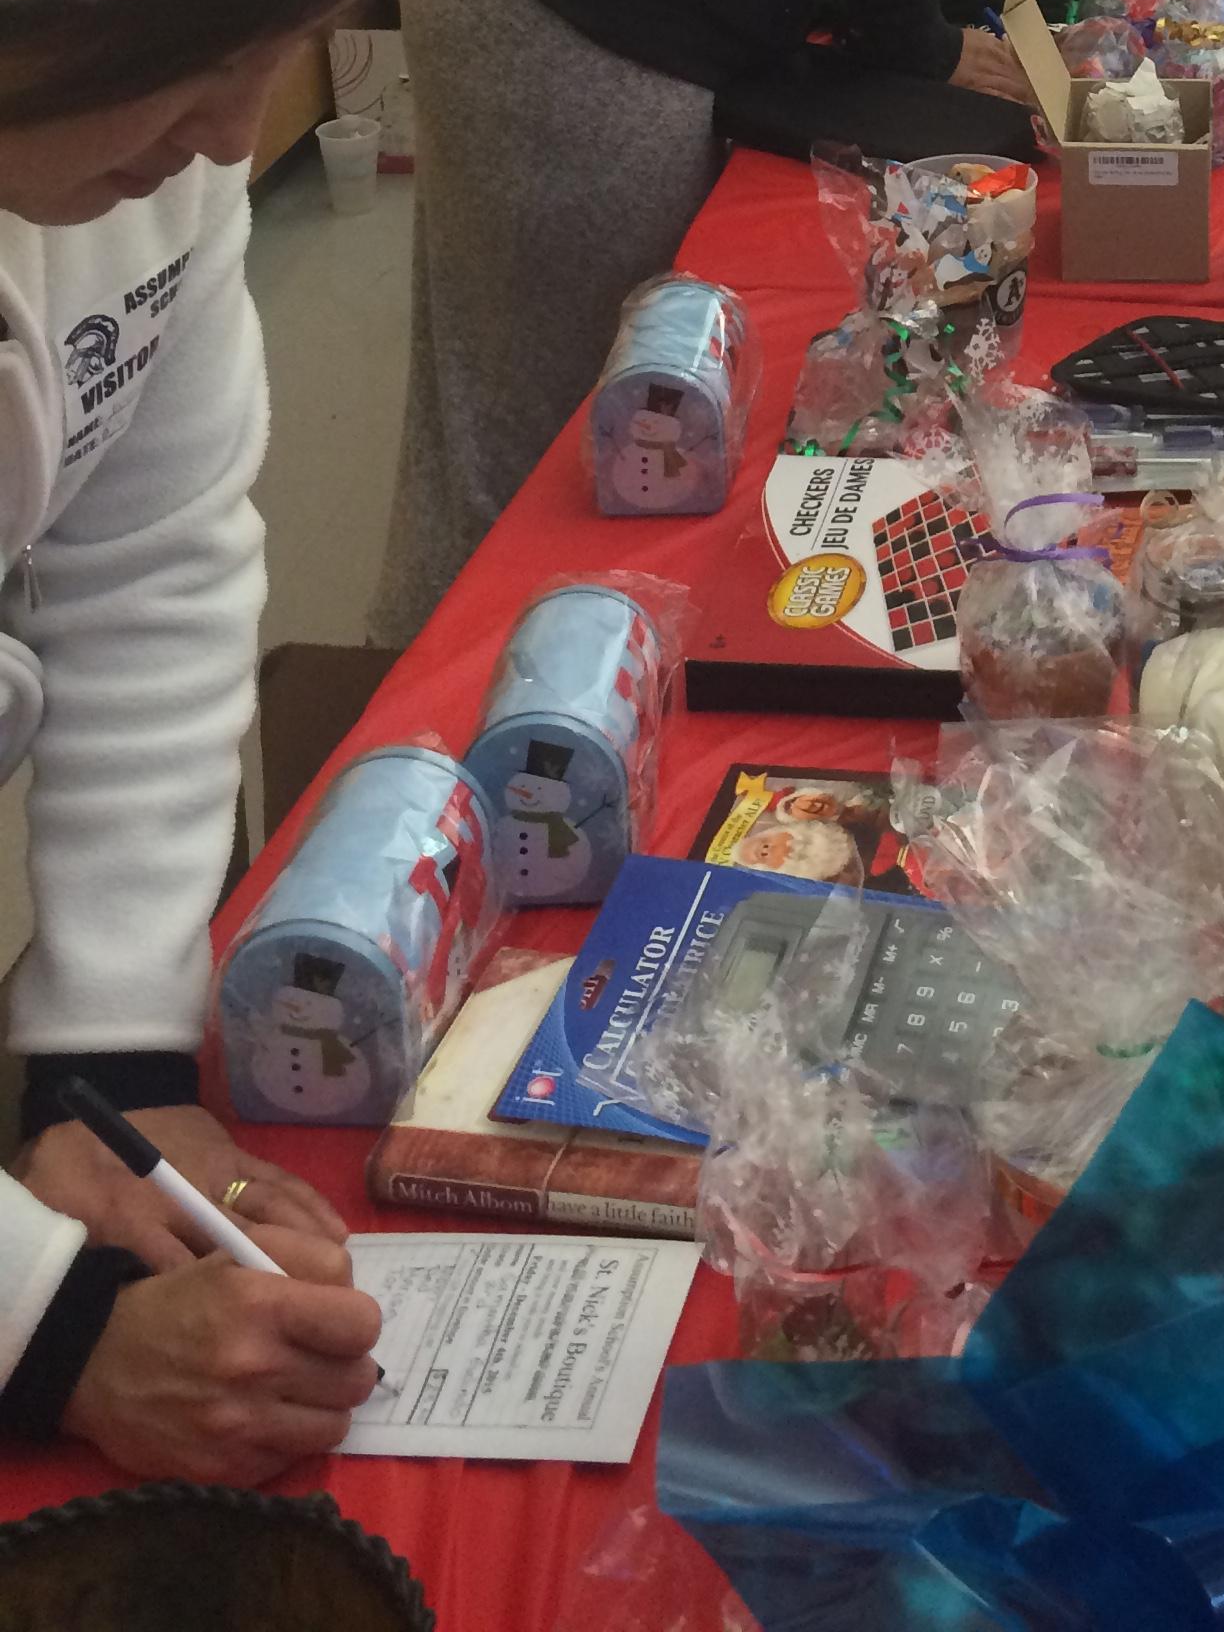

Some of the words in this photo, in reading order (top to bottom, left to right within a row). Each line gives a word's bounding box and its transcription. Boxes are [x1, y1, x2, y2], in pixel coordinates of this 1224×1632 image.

[124, 248, 193, 315] ASSUMP
[150, 278, 183, 318] SCH
[81, 334, 160, 415] VISITOR
[839, 458, 876, 503] DAMES
[789, 468, 836, 536] CHECKERS
[831, 506, 857, 524] DE
[821, 528, 849, 550] JEU
[784, 566, 826, 617] CLASSIC
[810, 567, 851, 617] GAMES
[883, 943, 899, 963] M+
[582, 925, 676, 1071] CALCULATOR
[907, 1013, 925, 1026] 8
[916, 986, 935, 999] 9
[957, 991, 976, 1005] 6
[1001, 999, 1019, 1013] 3
[949, 1020, 967, 1033] 5
[399, 1181, 459, 1207] Mitch
[464, 1187, 534, 1215] Albom
[591, 1206, 601, 1218] a
[603, 1201, 645, 1221] little
[651, 1206, 695, 1227] faith
[520, 1255, 543, 1285] Friday
[595, 1259, 619, 1280] St.
[573, 1285, 610, 1336] Nick's
[541, 1342, 588, 1422] Boutique
